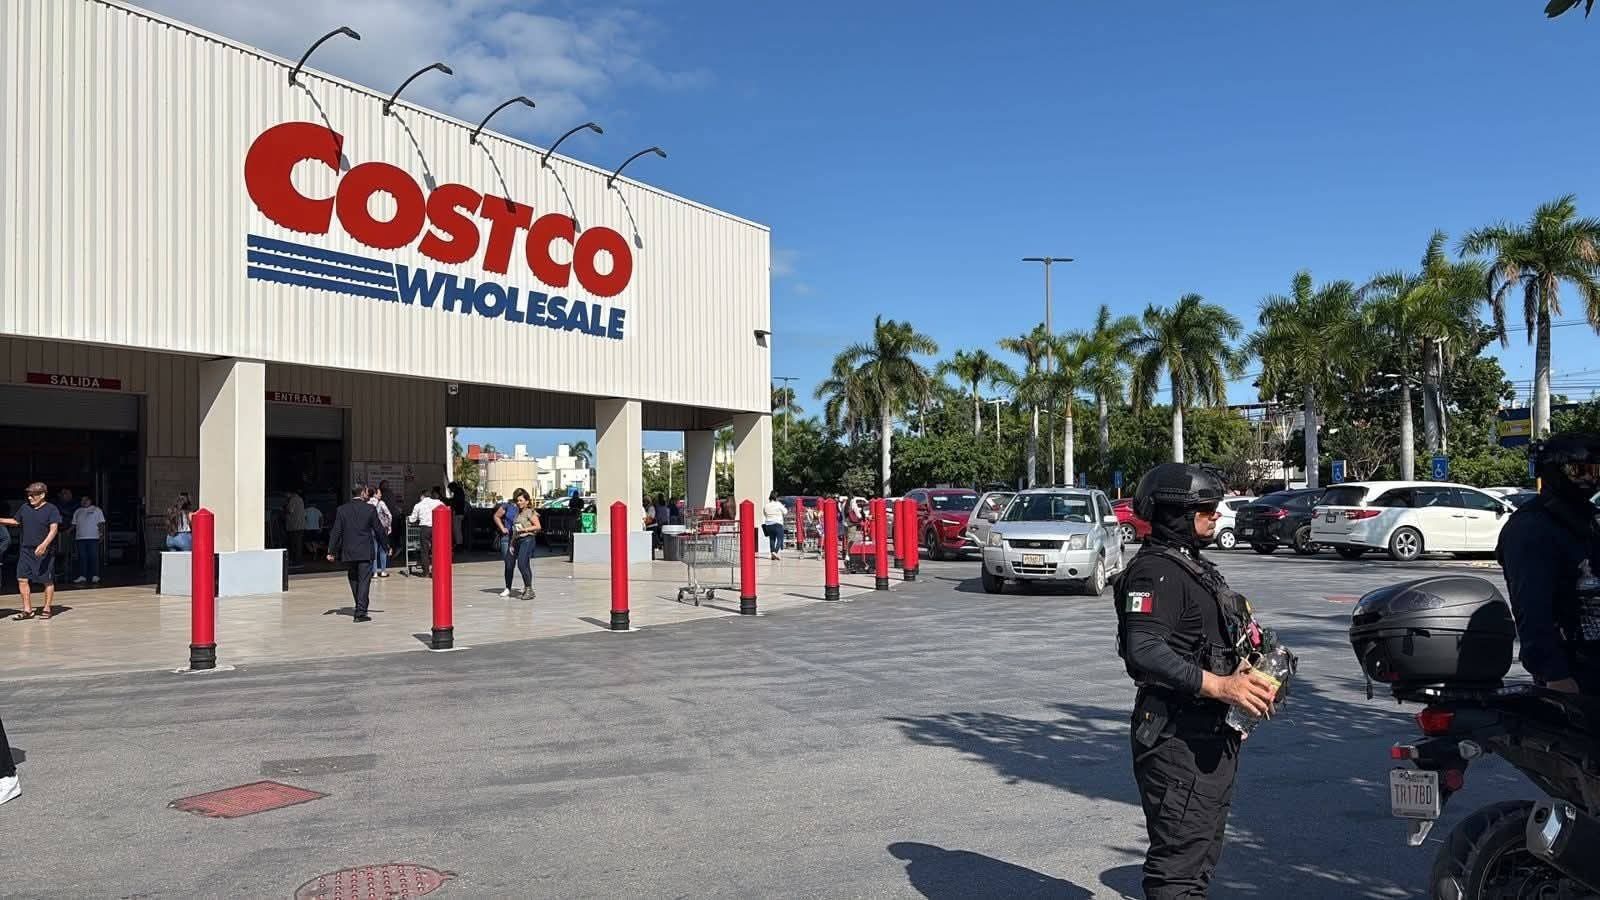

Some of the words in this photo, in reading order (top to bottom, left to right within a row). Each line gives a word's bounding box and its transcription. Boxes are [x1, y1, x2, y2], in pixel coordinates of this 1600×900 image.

[244, 122, 633, 298] COSTCO
[394, 264, 626, 340] WHOLESALE
[50, 375, 100, 388] SALIDA
[274, 392, 321, 405] ENTRADA
